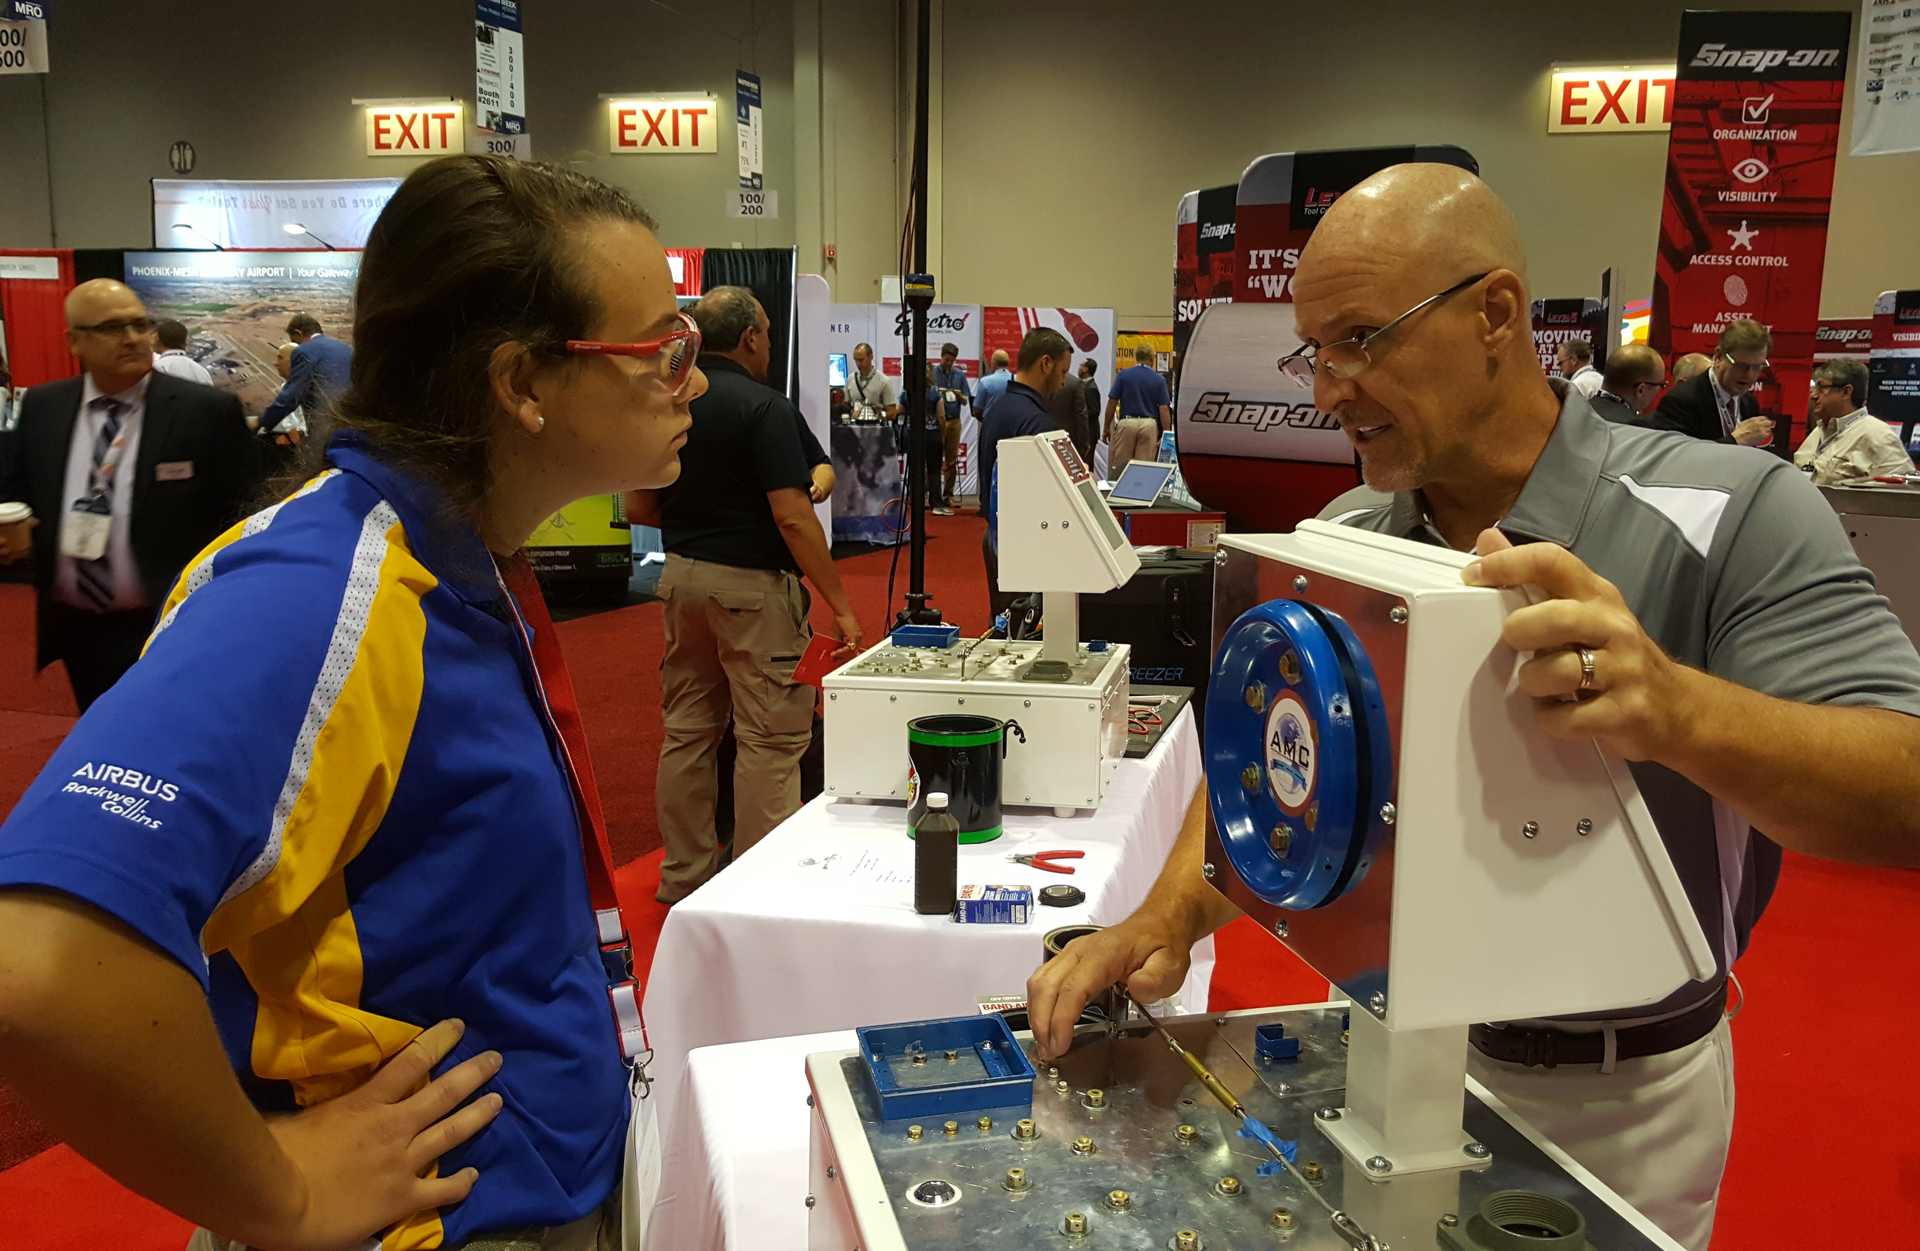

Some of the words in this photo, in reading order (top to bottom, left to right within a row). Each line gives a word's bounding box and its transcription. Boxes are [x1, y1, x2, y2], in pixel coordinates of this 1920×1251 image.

[15, 1, 43, 18] MRO
[1690, 43, 1839, 73] Snap-on
[478, 87, 500, 99] Booth
[478, 96, 500, 107] #2611
[1561, 78, 1676, 125] EXIT
[373, 113, 455, 150] EXIT
[505, 121, 521, 131] MRO
[618, 108, 708, 147] EXIT
[1713, 129, 1797, 140] ORGANIZATION
[487, 139, 516, 154] 300/
[740, 193, 765, 204] 100/
[1717, 191, 1777, 202] VISIBILITY
[741, 205, 763, 215] 200
[1304, 207, 1319, 215] Tool
[1690, 255, 1732, 265] ACCESS
[1735, 255, 1789, 267] CONTROL
[247, 267, 284, 277] AIRPORT
[297, 267, 316, 277] Your
[317, 268, 354, 279] Gateway
[1715, 312, 1752, 322] ASSET
[986, 327, 1009, 335] cable
[1532, 330, 1592, 343] MOVING
[1816, 326, 1872, 342] Snap-o
[1538, 344, 1554, 354] AT
[1190, 392, 1341, 432] Snap-on
[600, 553, 624, 563] BRICK
[1270, 731, 1310, 768] AMC
[72, 762, 180, 802] AIRBUS
[61, 782, 150, 813] Rockwell
[101, 800, 163, 829] Collins
